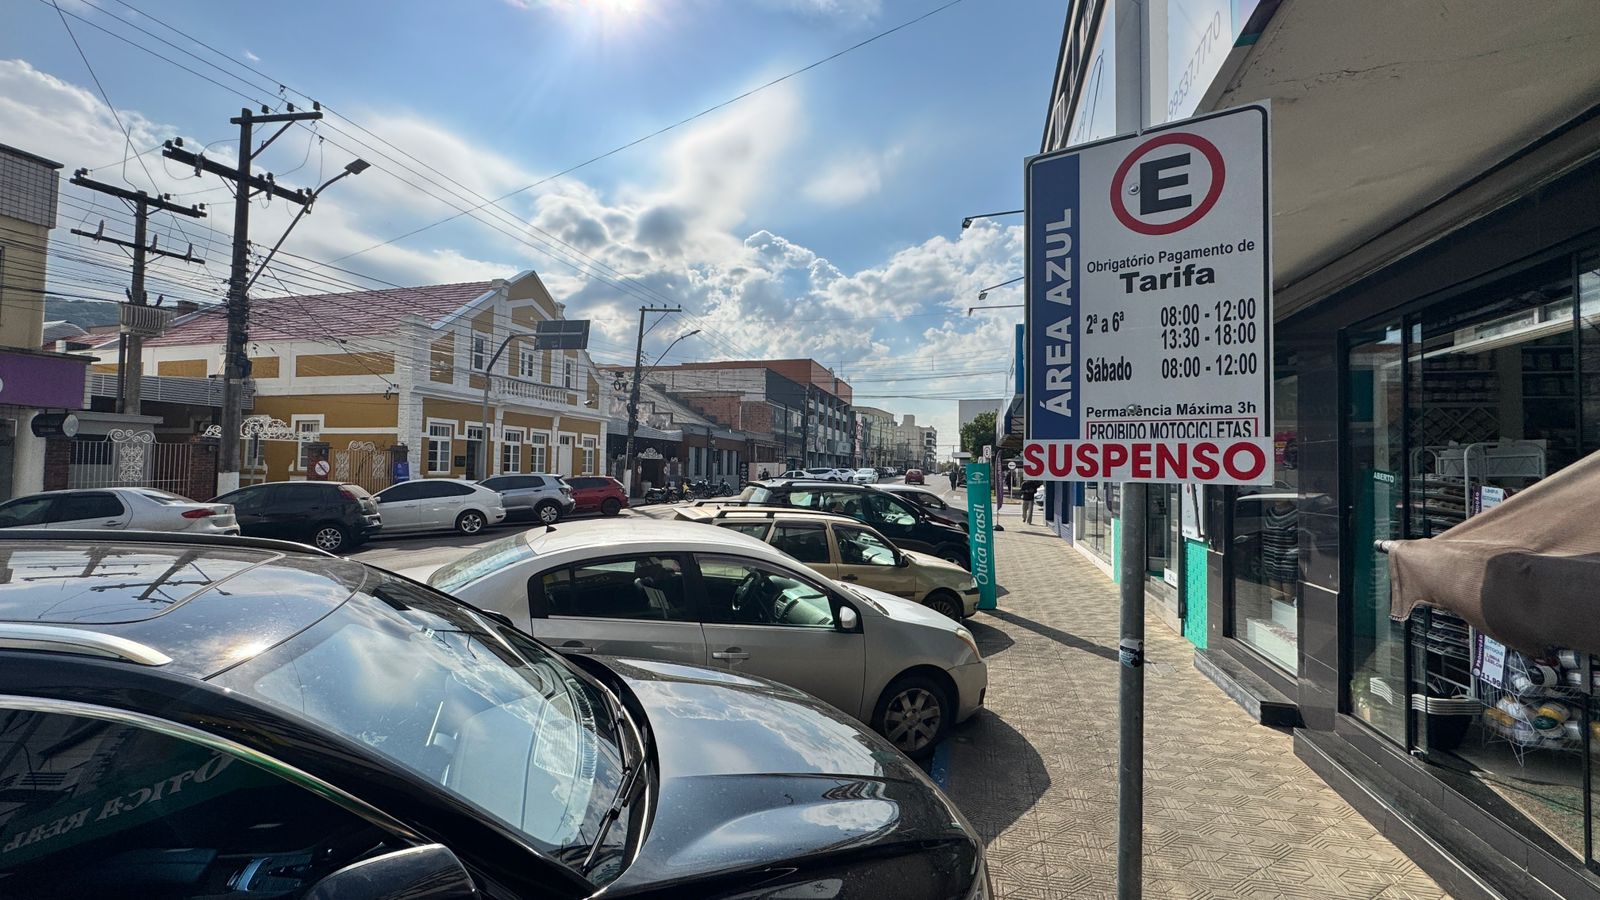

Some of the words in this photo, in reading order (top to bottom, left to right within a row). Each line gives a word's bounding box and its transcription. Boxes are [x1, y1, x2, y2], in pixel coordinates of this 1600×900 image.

[1140, 152, 1192, 216] E
[1044, 208, 1072, 306] AZUL
[1086, 252, 1155, 274] Obrigatório
[1158, 242, 1233, 265] Pagamento
[1237, 238, 1255, 253] de
[1119, 264, 1216, 294] Tarifa
[1100, 318, 1109, 333] a
[1160, 304, 1201, 328] 08:00
[1214, 298, 1256, 323] 12:00
[1160, 327, 1200, 350] 13:30
[1214, 322, 1256, 346] 18:00
[1039, 312, 1072, 418] ÁREA
[1086, 354, 1132, 383] Sábado
[1161, 356, 1201, 380] 08:00
[1215, 352, 1257, 376] 12:00
[1176, 402, 1233, 416] Máxima
[1237, 402, 1256, 415] 3h
[1090, 422, 1146, 440] PROIBIDO
[1150, 420, 1252, 440] MOTOCICLETAS
[1023, 442, 1266, 481] SUSPENSO
[1374, 472, 1394, 483] ABERTO
[974, 503, 986, 543] Brasil
[975, 548, 988, 585] Ótica
